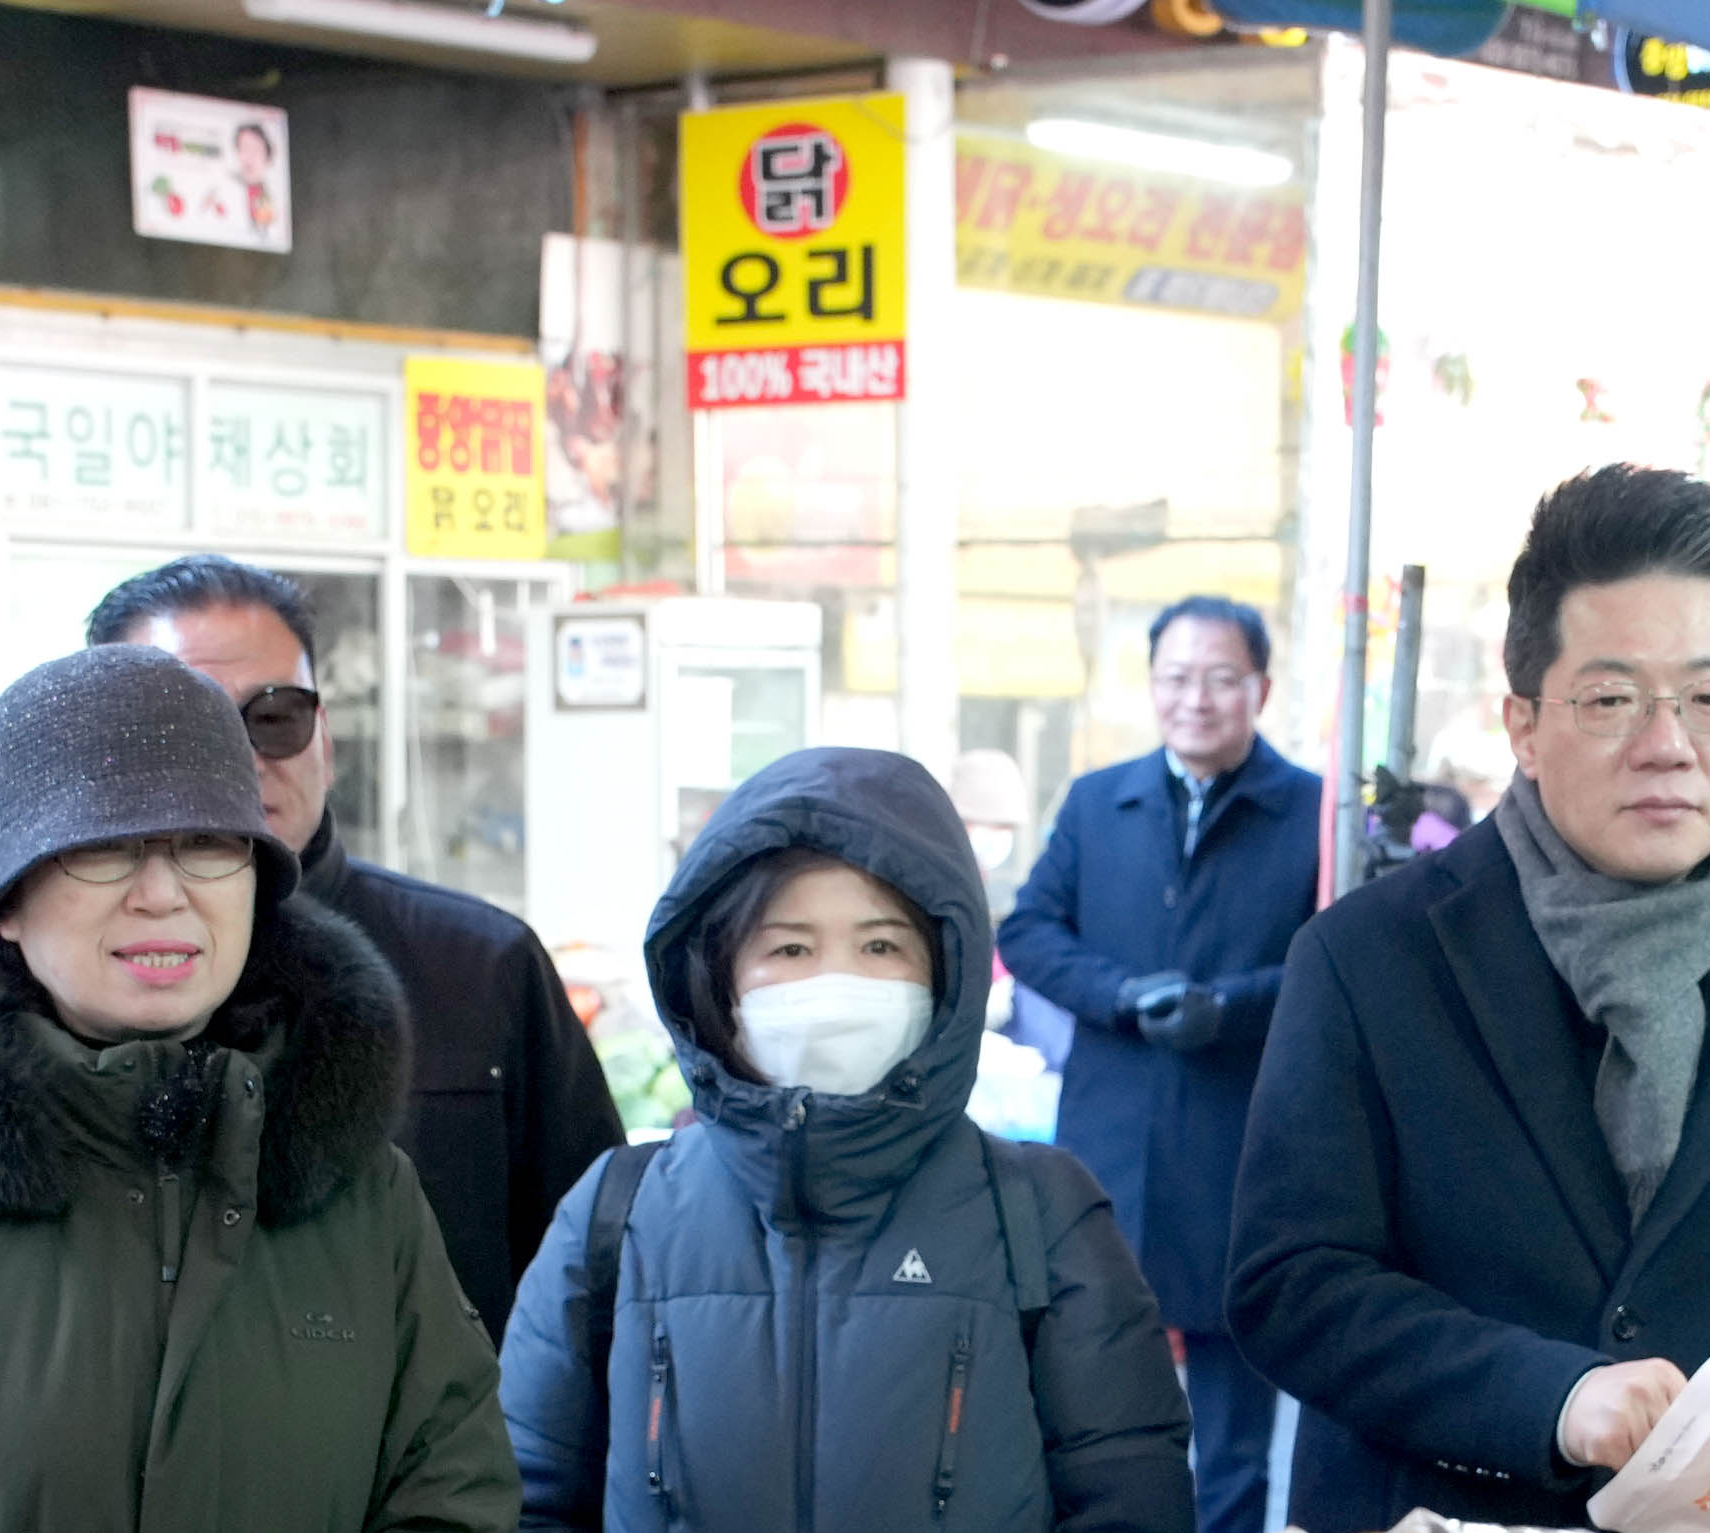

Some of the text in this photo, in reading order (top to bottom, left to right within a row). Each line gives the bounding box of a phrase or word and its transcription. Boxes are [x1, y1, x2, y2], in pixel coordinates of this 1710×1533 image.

[758, 138, 835, 224] 닭
[715, 244, 875, 326] 오리
[699, 344, 899, 401] 100% 국내산
[473, 487, 527, 533] 오리
